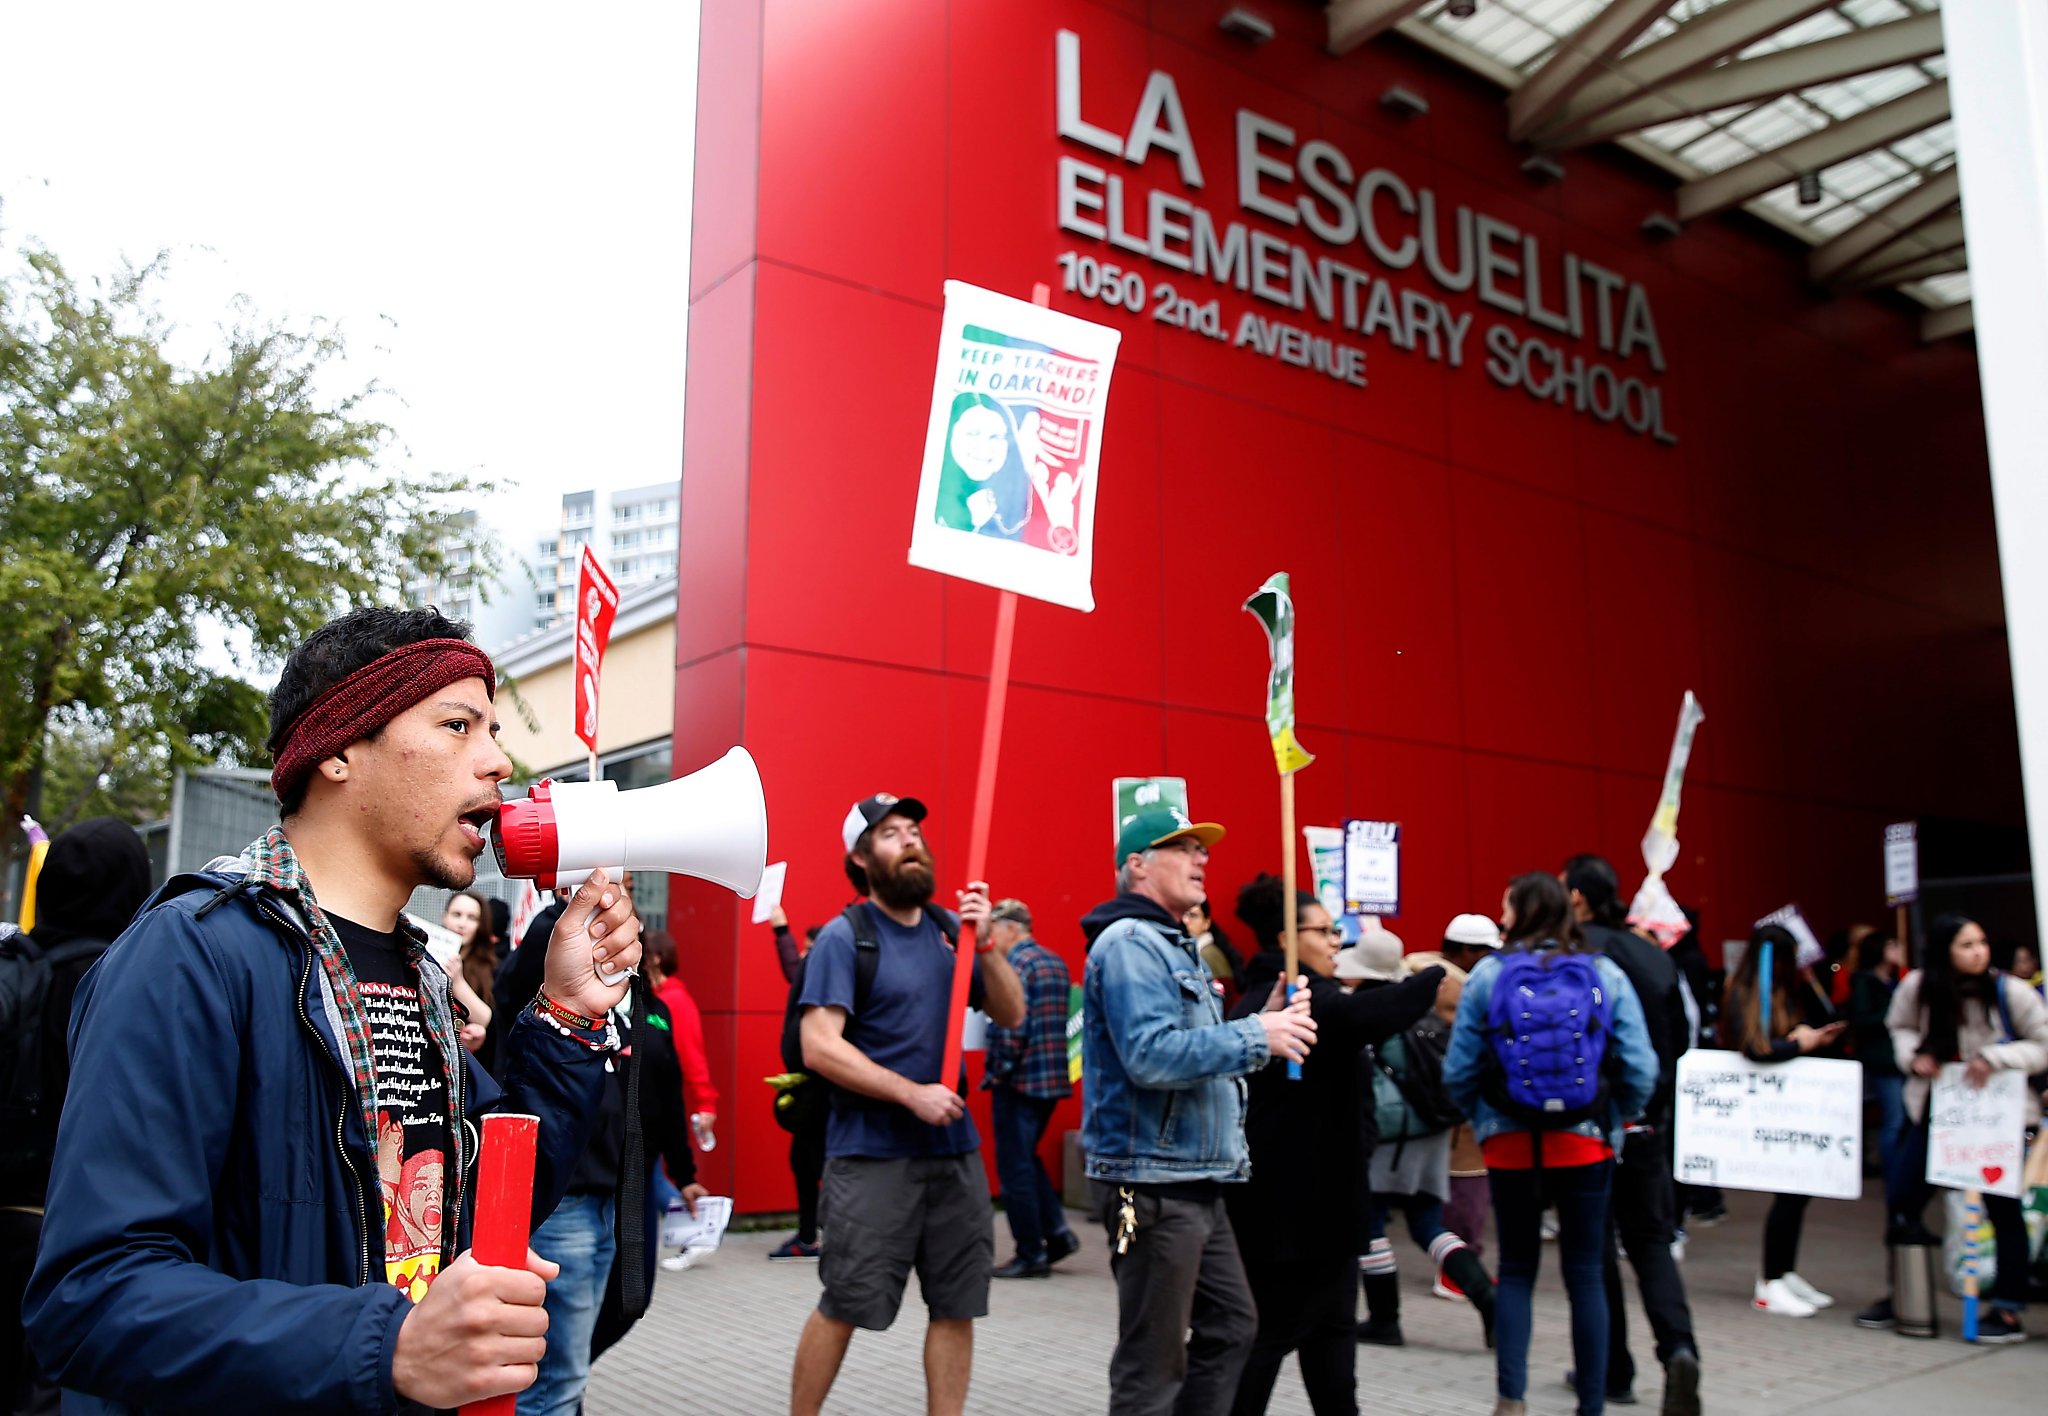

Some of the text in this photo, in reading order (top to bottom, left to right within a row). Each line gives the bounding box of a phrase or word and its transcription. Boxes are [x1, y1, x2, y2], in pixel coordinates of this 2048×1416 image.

[1056, 29, 1666, 371] LA ESCUELITA
[1058, 156, 1677, 444] ELEMENTARY SCHOOL
[1060, 251, 1367, 388] 1050 2nd. AVENUE
[958, 368, 1095, 404] IN OAKLAND!
[961, 347, 1099, 382] KEEP TEACHERS
[538, 994, 555, 1011] BLOOD
[555, 1007, 591, 1028] CAMPAIGN
